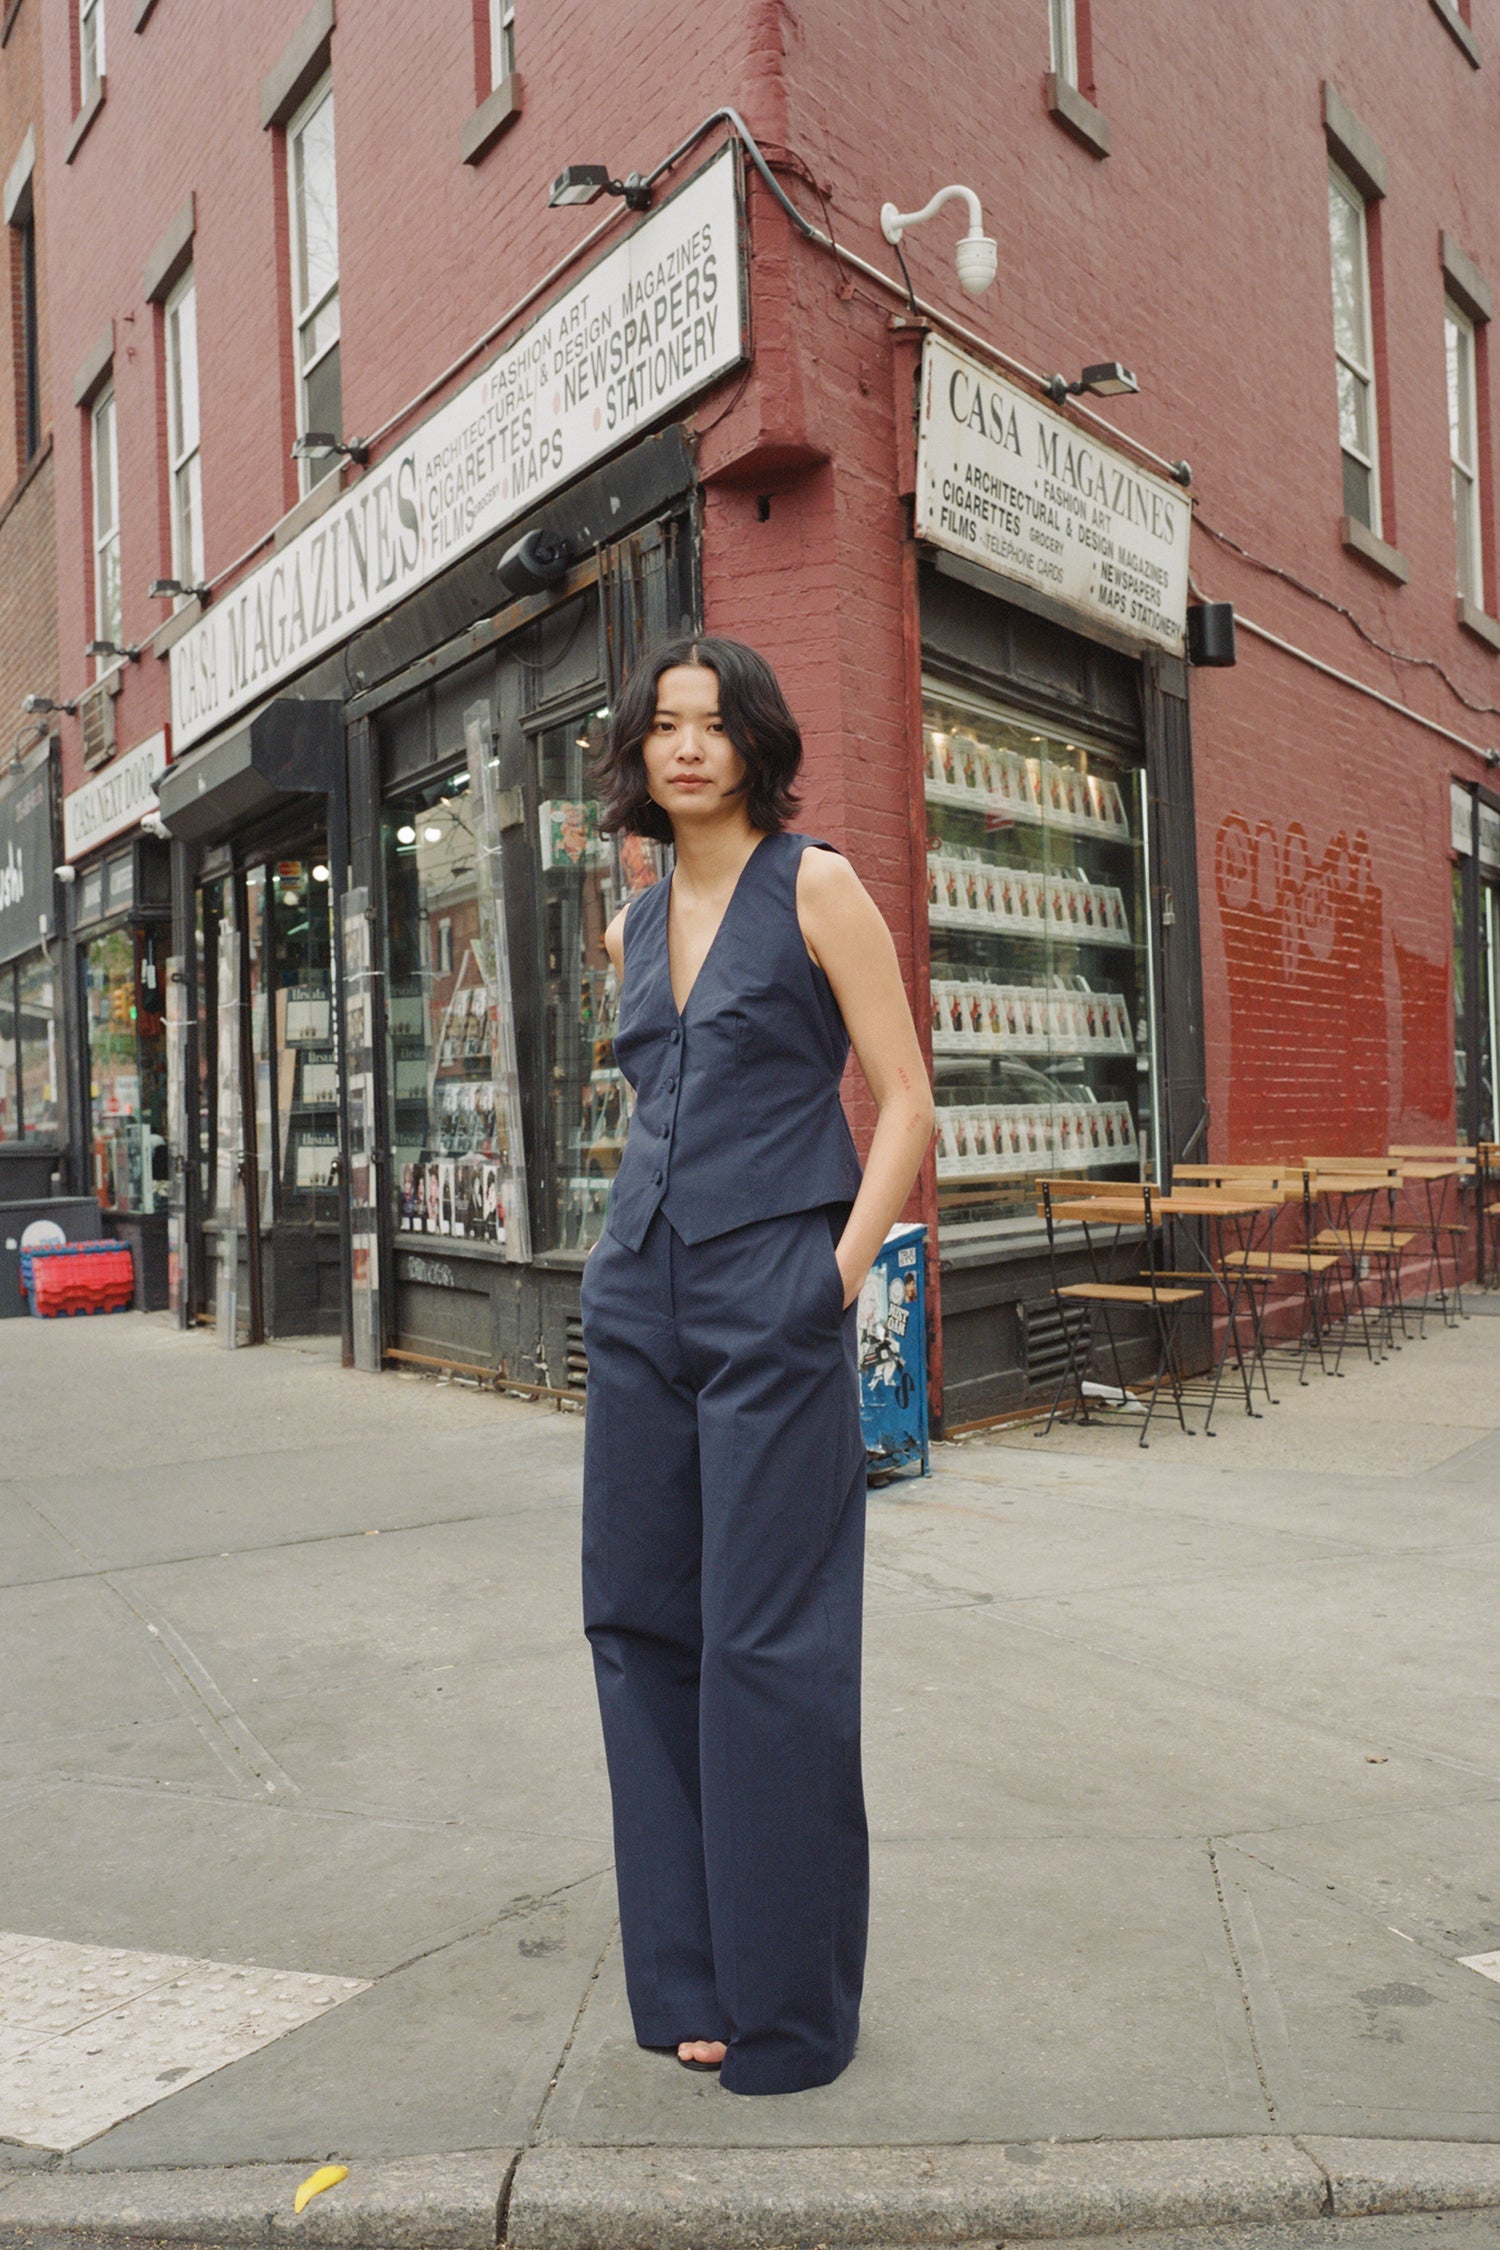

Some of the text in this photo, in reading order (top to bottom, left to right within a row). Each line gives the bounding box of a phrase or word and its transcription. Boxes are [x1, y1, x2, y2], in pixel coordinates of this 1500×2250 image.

[425, 223, 712, 482] ARCHITECTURAL & DESIGN MAGAZINES
[429, 254, 718, 521] CIGARETTES NEWSPAPERS
[491, 294, 589, 399] FASHION ART
[431, 495, 475, 559] FILMS
[512, 428, 564, 499] MAPS
[606, 304, 718, 430] STATIONERY
[950, 369, 1175, 545] CASA MAGAZINES
[943, 479, 1162, 607] CIGARETTES GROCERY NEWSPAPERS
[965, 463, 1169, 589] ARCHITECTURAL & DESIGN MAGAZINES
[1044, 480, 1112, 534] FASHION ART
[176, 451, 421, 730] CASA MAGAZINES
[940, 506, 1181, 639] FILMS TELEPHONE CARDS MAPS STATIONERY
[73, 794, 96, 841] CASA
[97, 774, 122, 823] NEXT
[125, 753, 154, 809] DOOR
[292, 988, 326, 1000] Ursula
[308, 1052, 335, 1064] Ursul
[303, 1133, 336, 1146] Ursula
